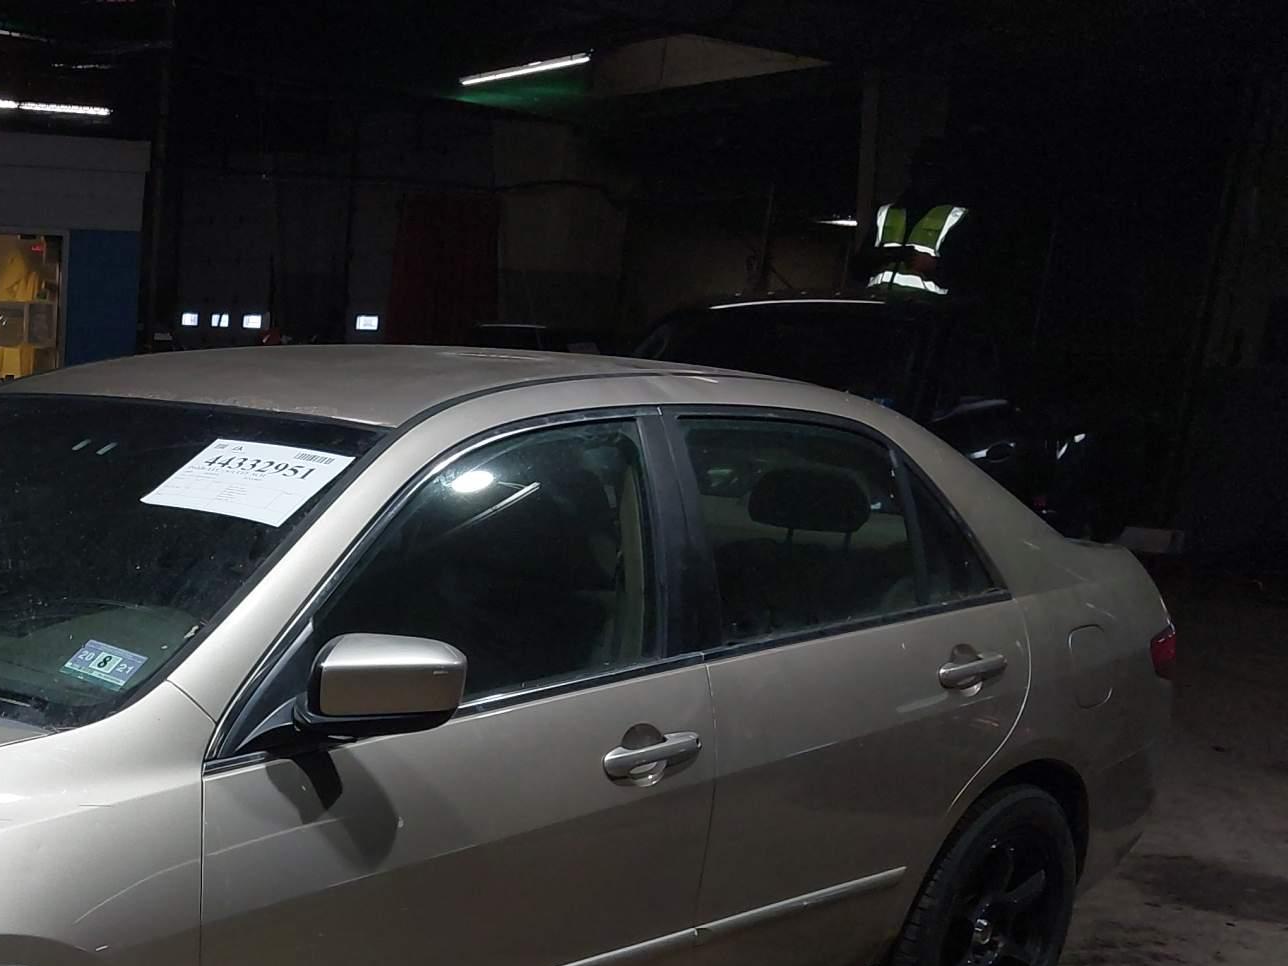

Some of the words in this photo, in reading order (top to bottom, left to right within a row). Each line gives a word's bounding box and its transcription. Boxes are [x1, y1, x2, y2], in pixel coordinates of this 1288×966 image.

[204, 455, 317, 479] 44332951
[78, 650, 96, 661] 20
[97, 655, 112, 669] 8
[116, 663, 135, 675] 21
